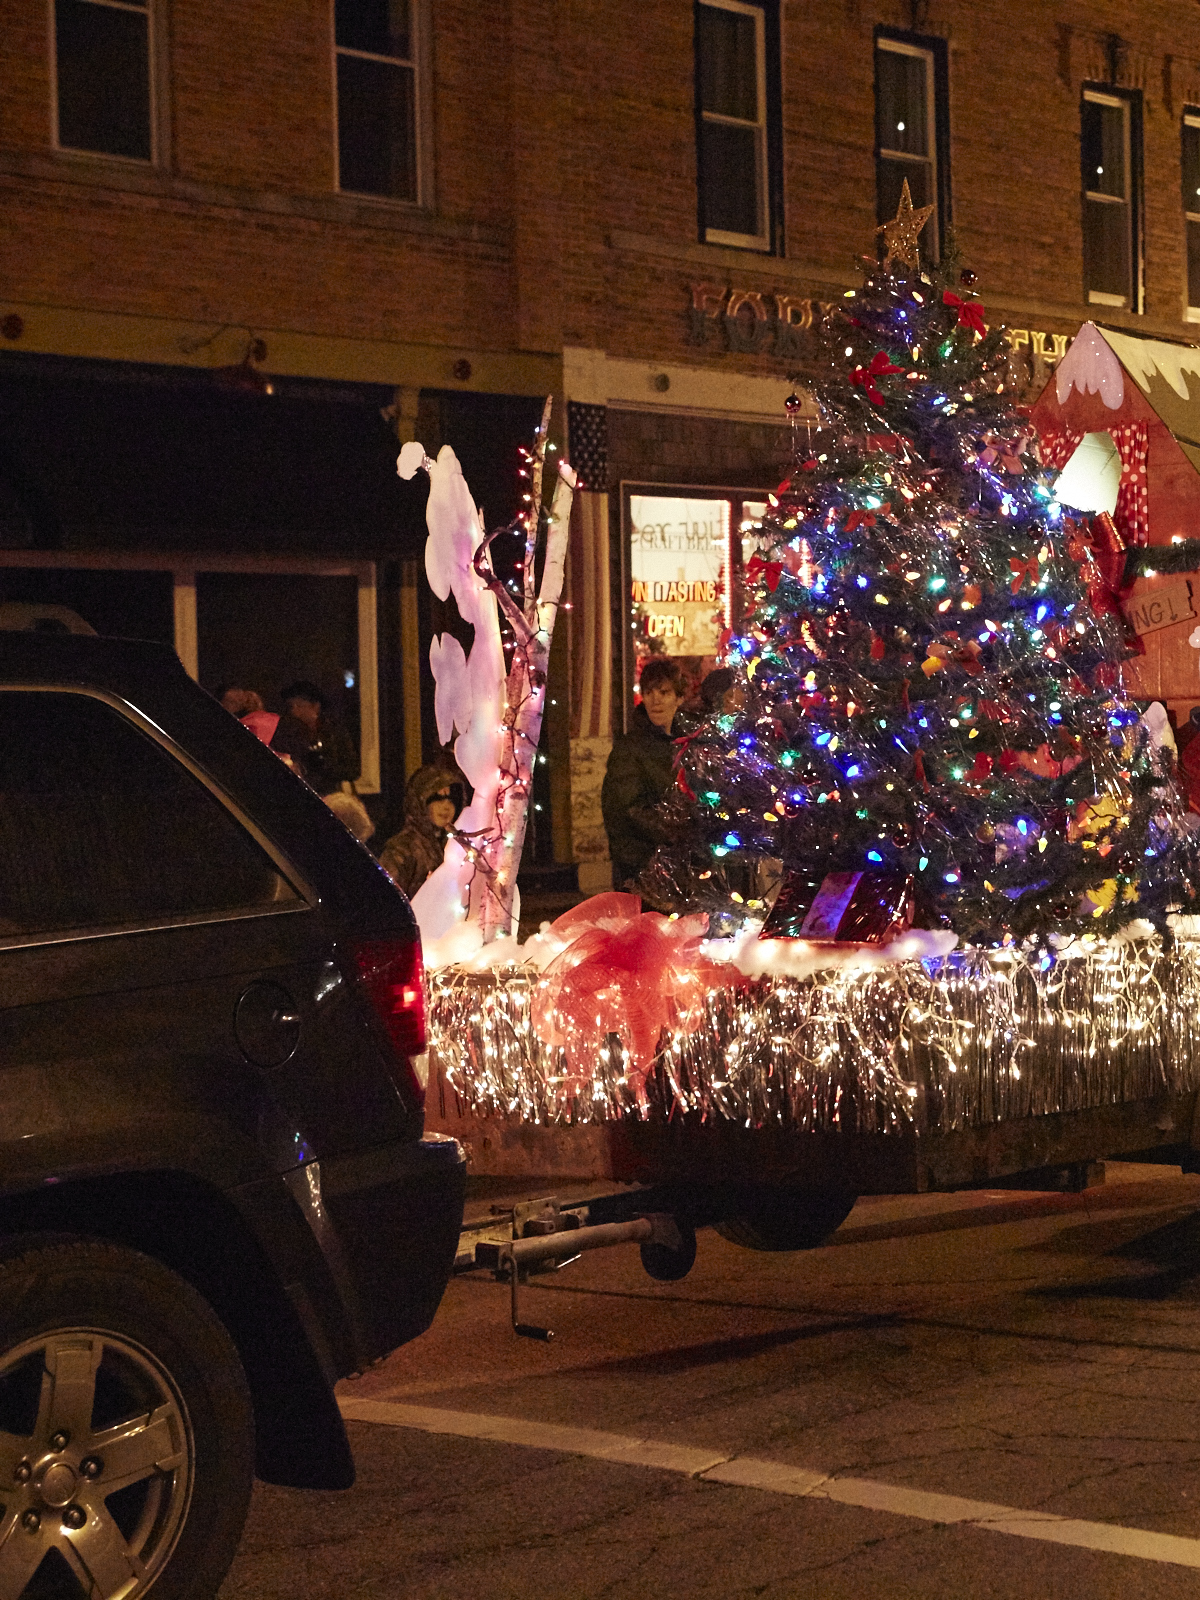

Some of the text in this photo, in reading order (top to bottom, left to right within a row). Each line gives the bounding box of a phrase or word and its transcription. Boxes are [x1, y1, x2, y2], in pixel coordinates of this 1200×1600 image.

[689, 282, 838, 352] FOR
[659, 581, 716, 602] TASTING
[647, 615, 684, 637] OPEN
